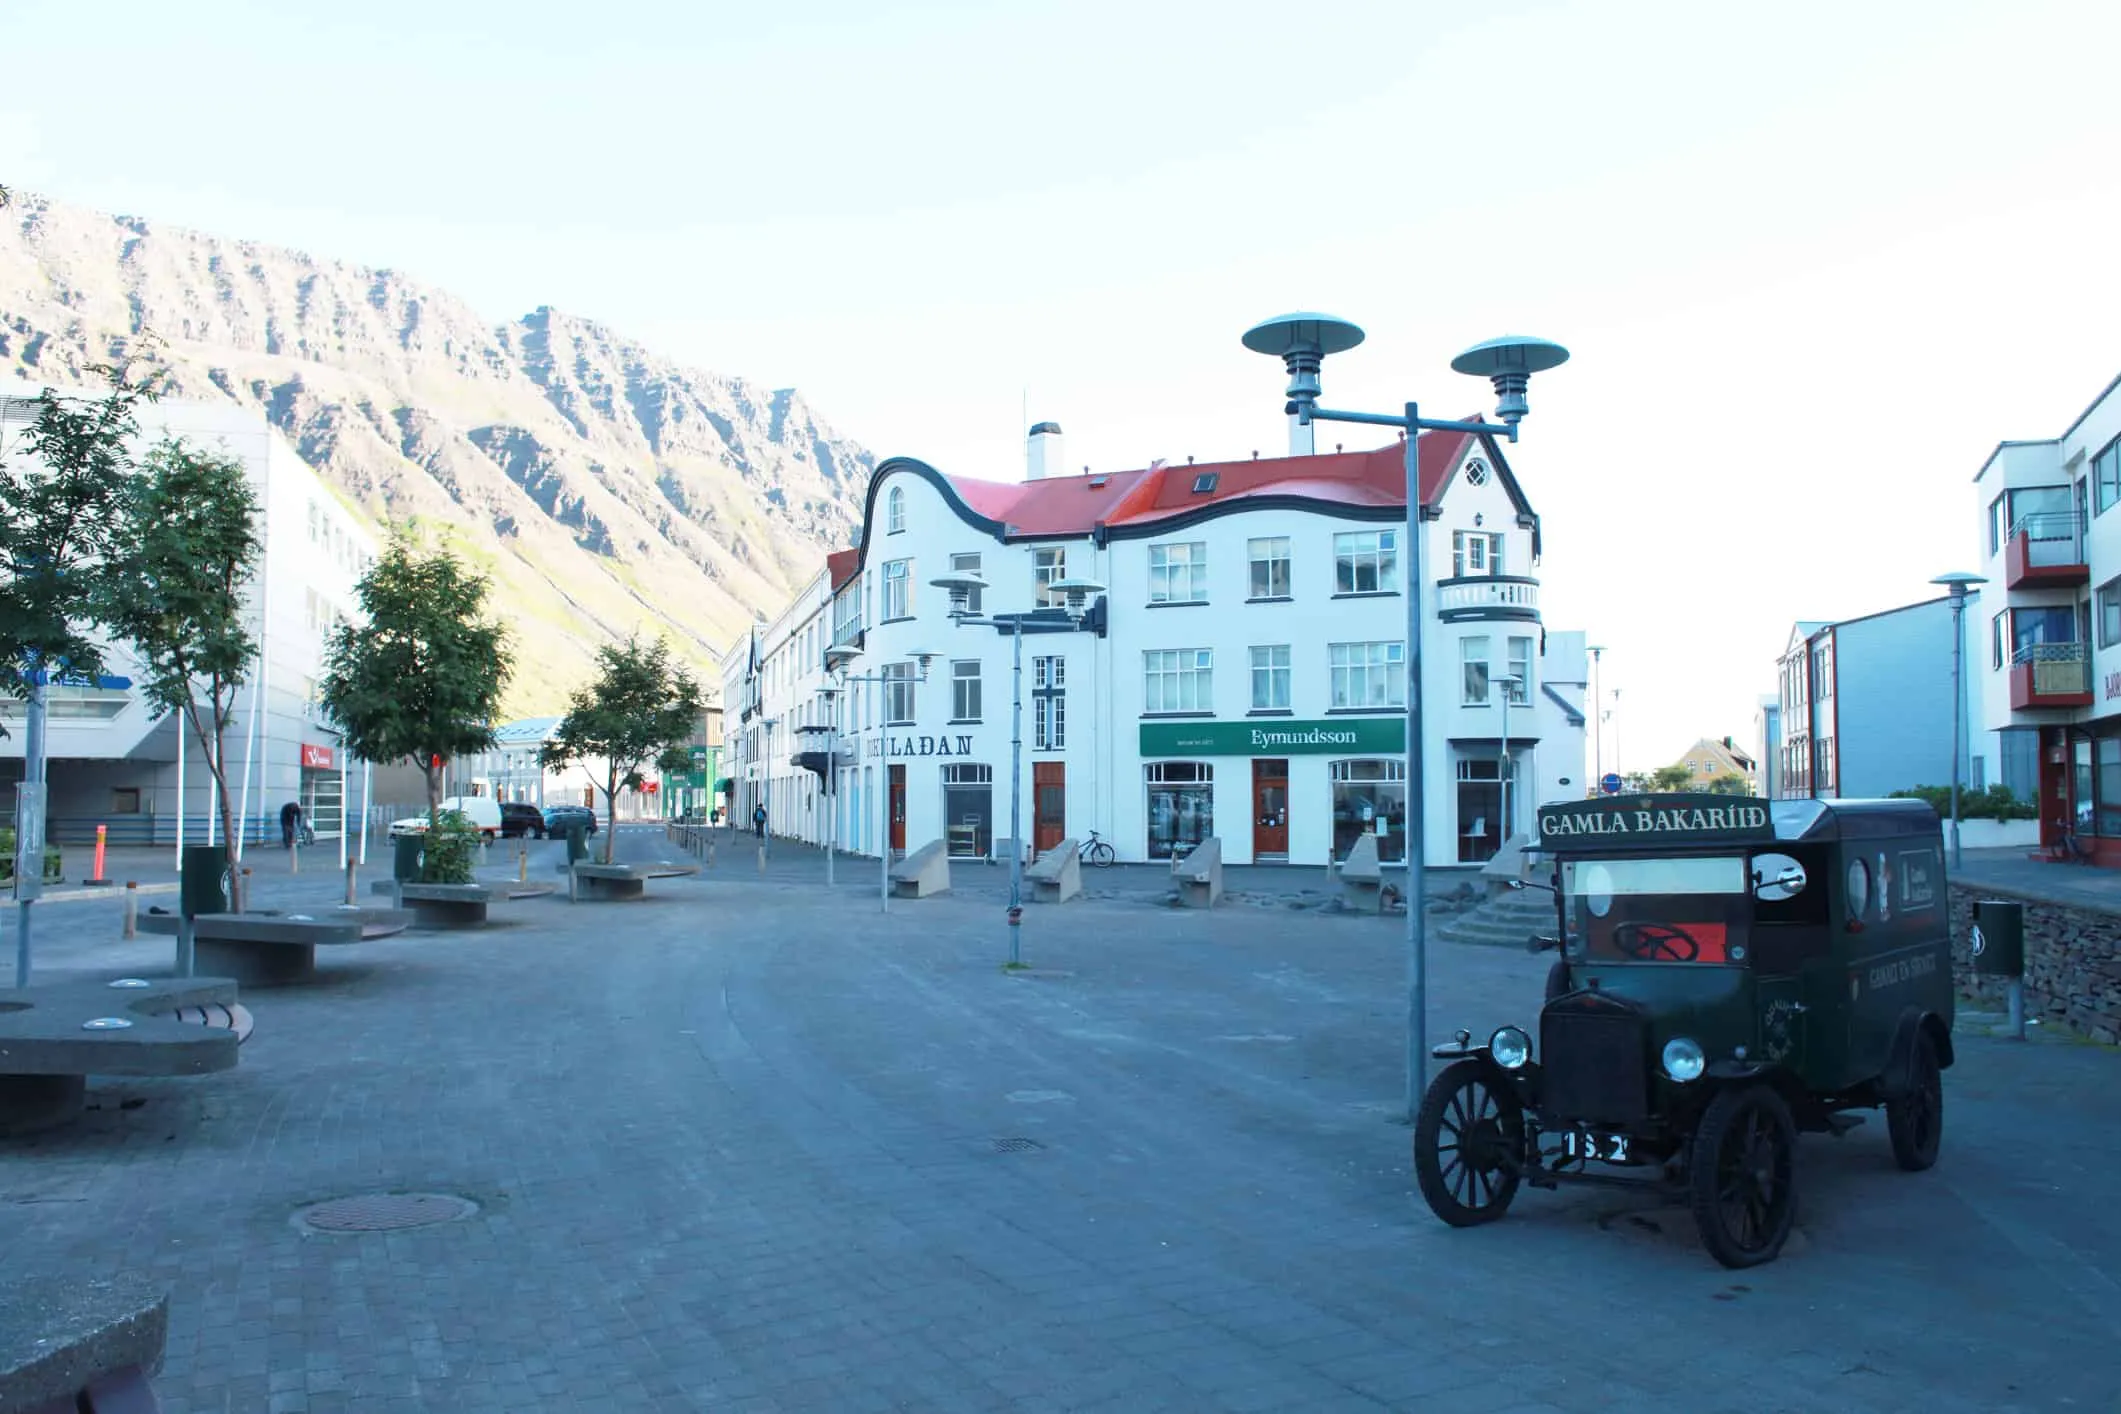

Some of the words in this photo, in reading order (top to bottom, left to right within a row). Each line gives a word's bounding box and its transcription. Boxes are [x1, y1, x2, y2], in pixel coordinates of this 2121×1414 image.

[1251, 727, 1356, 749] Eymundsson
[1541, 811, 1629, 836] GAMLA
[1635, 804, 1766, 833] BAKARÍIÐ
